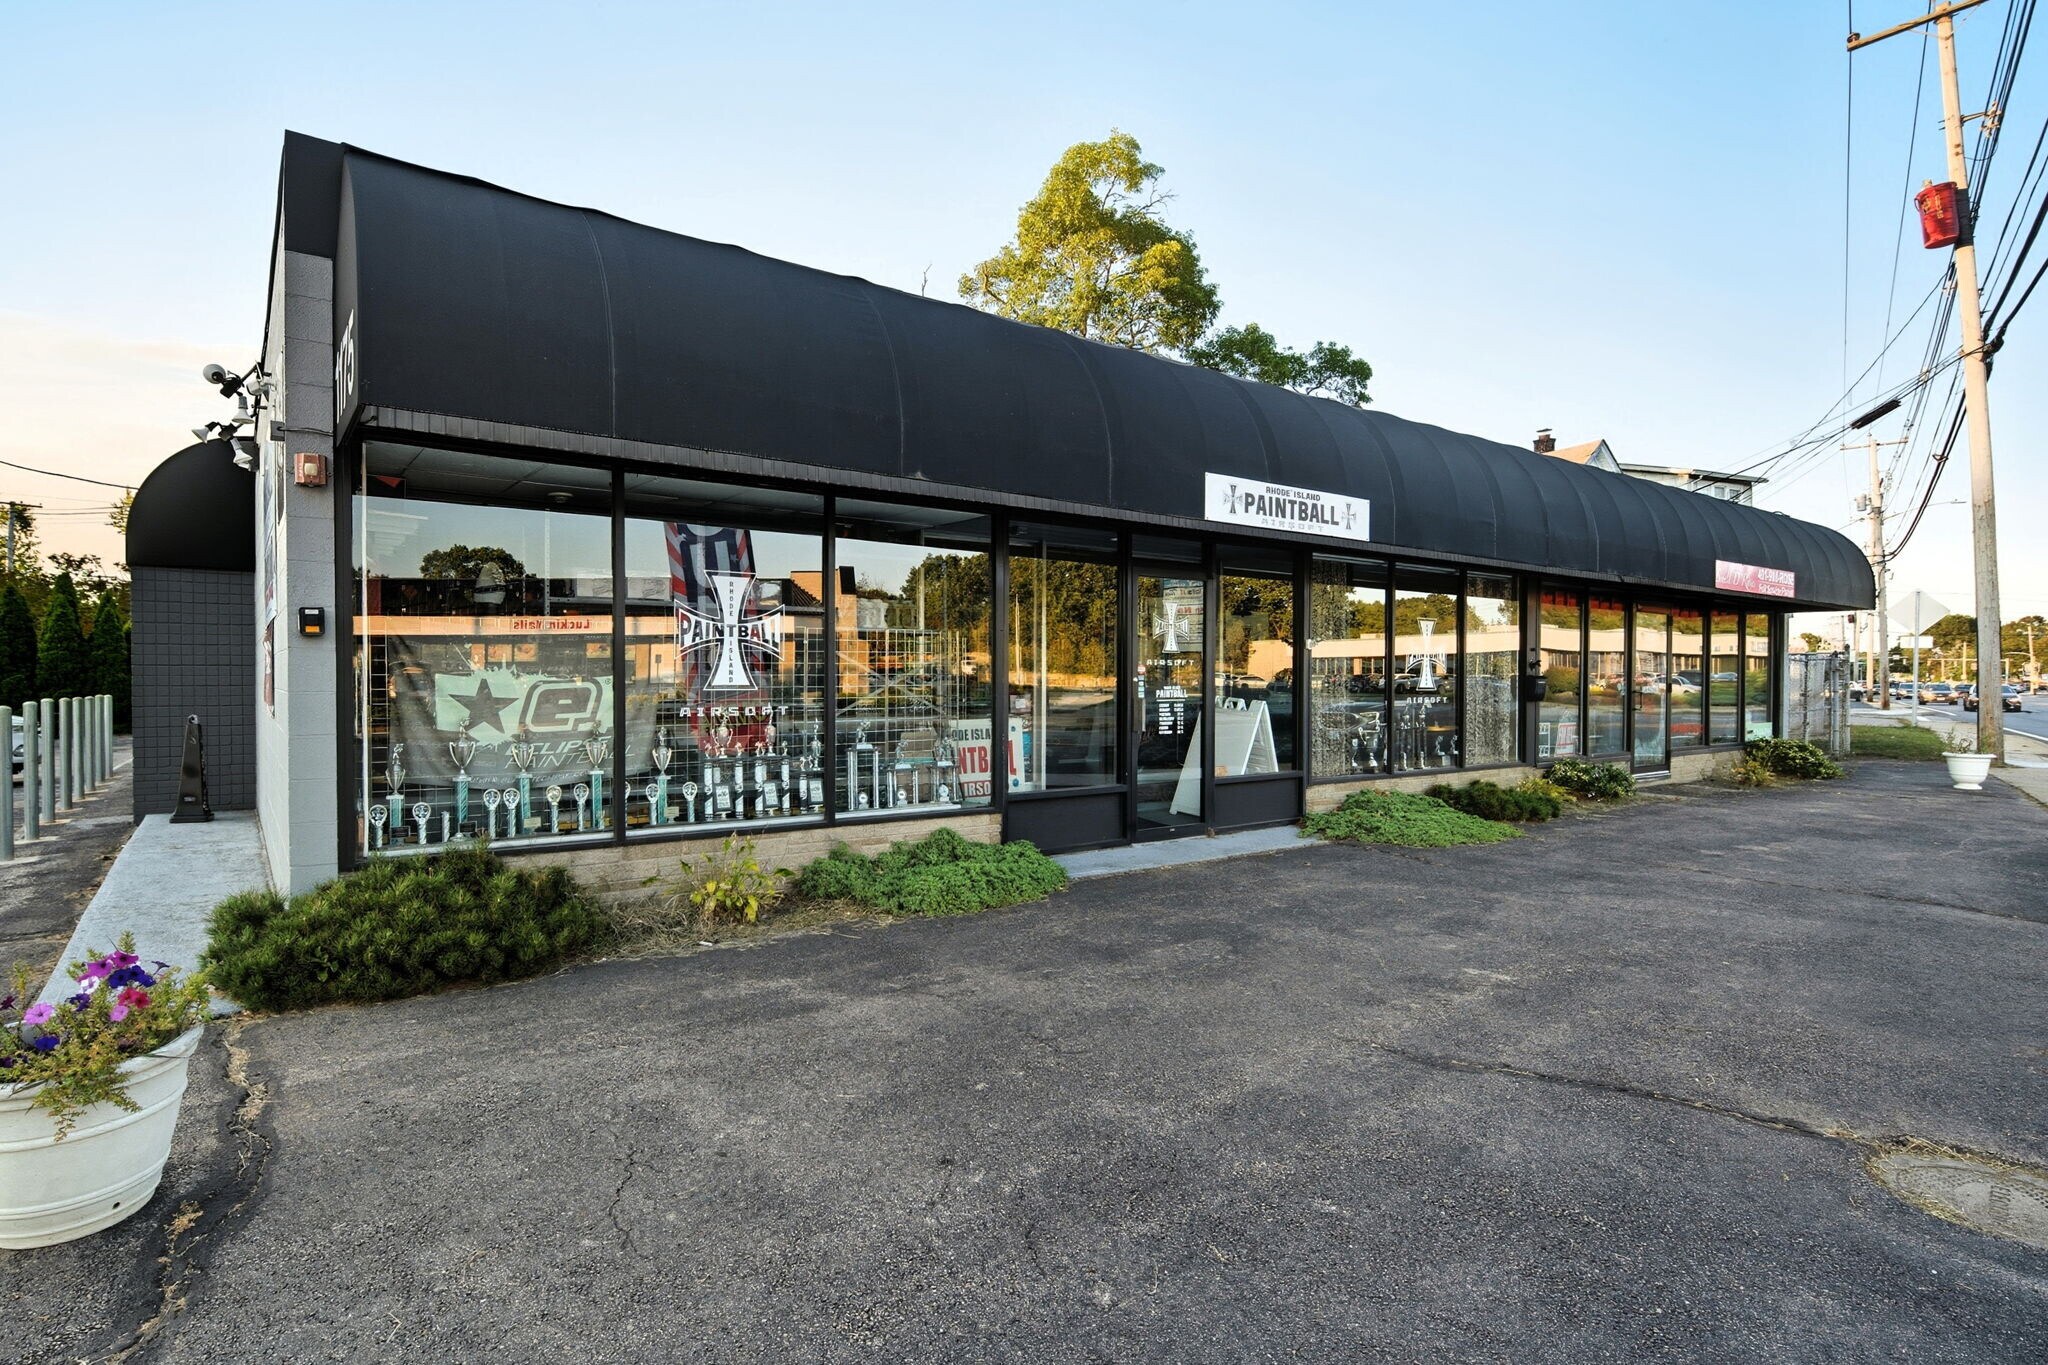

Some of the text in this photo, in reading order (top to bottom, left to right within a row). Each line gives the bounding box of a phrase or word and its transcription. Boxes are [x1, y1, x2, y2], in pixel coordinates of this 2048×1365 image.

[335, 308, 354, 425] 1175
[1265, 486, 1321, 502] RHODE ISLAND
[1244, 492, 1340, 526] PAINTBALL
[1261, 518, 1324, 533] AIRSOFT
[679, 609, 780, 653] PAINTBALL
[1155, 689, 1188, 698] PAINTBALL
[679, 704, 789, 718] AIRSOFT
